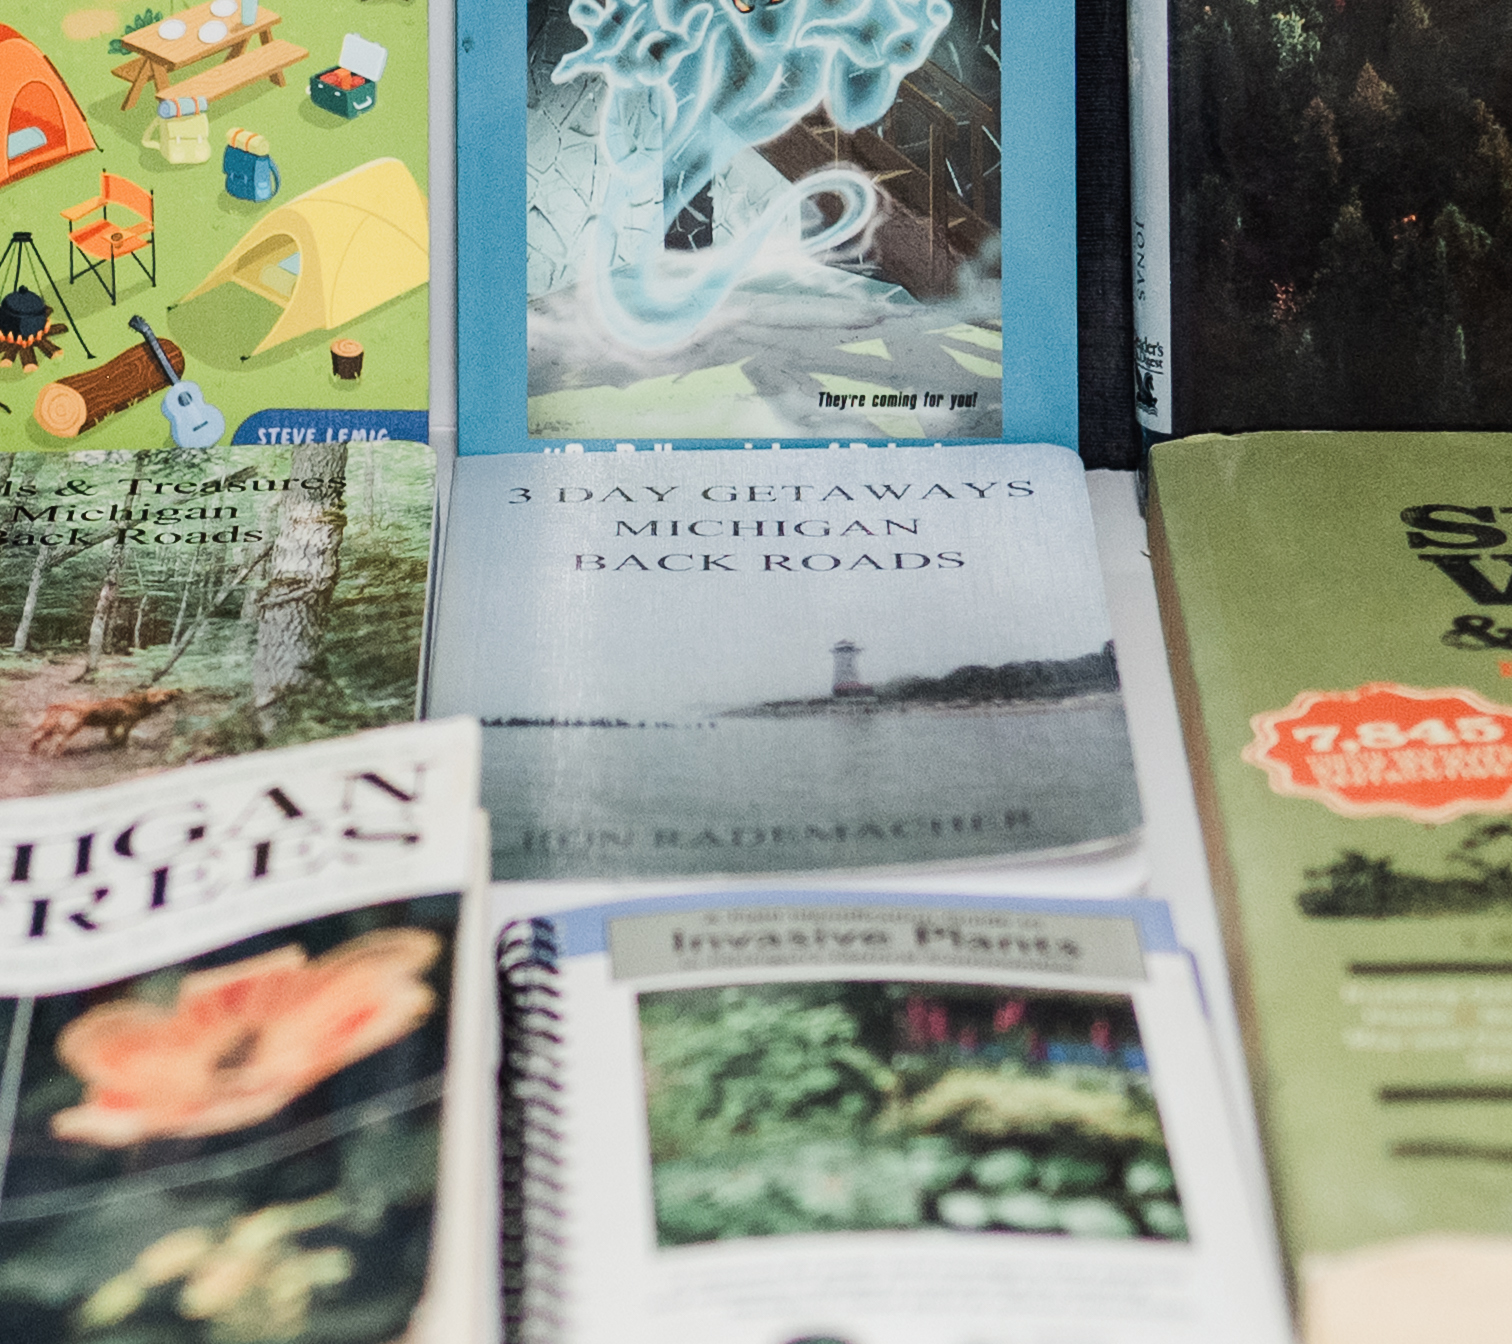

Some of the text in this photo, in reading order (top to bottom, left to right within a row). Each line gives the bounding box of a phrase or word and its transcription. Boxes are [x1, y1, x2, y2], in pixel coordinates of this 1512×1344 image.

[1135, 219, 1146, 303] JONAS
[818, 391, 979, 411] They're coming for you!
[257, 427, 390, 445] STEVE LEMIG
[52, 479, 96, 496] &
[121, 474, 349, 496] Treasures
[509, 480, 1036, 505] 3 DAY GETAWAYS
[8, 505, 239, 526] Michigan
[108, 524, 266, 547] Roads
[614, 517, 921, 538] MICHIGAN
[573, 550, 967, 573] BACK ROADS
[1292, 718, 1504, 754] 7,845
